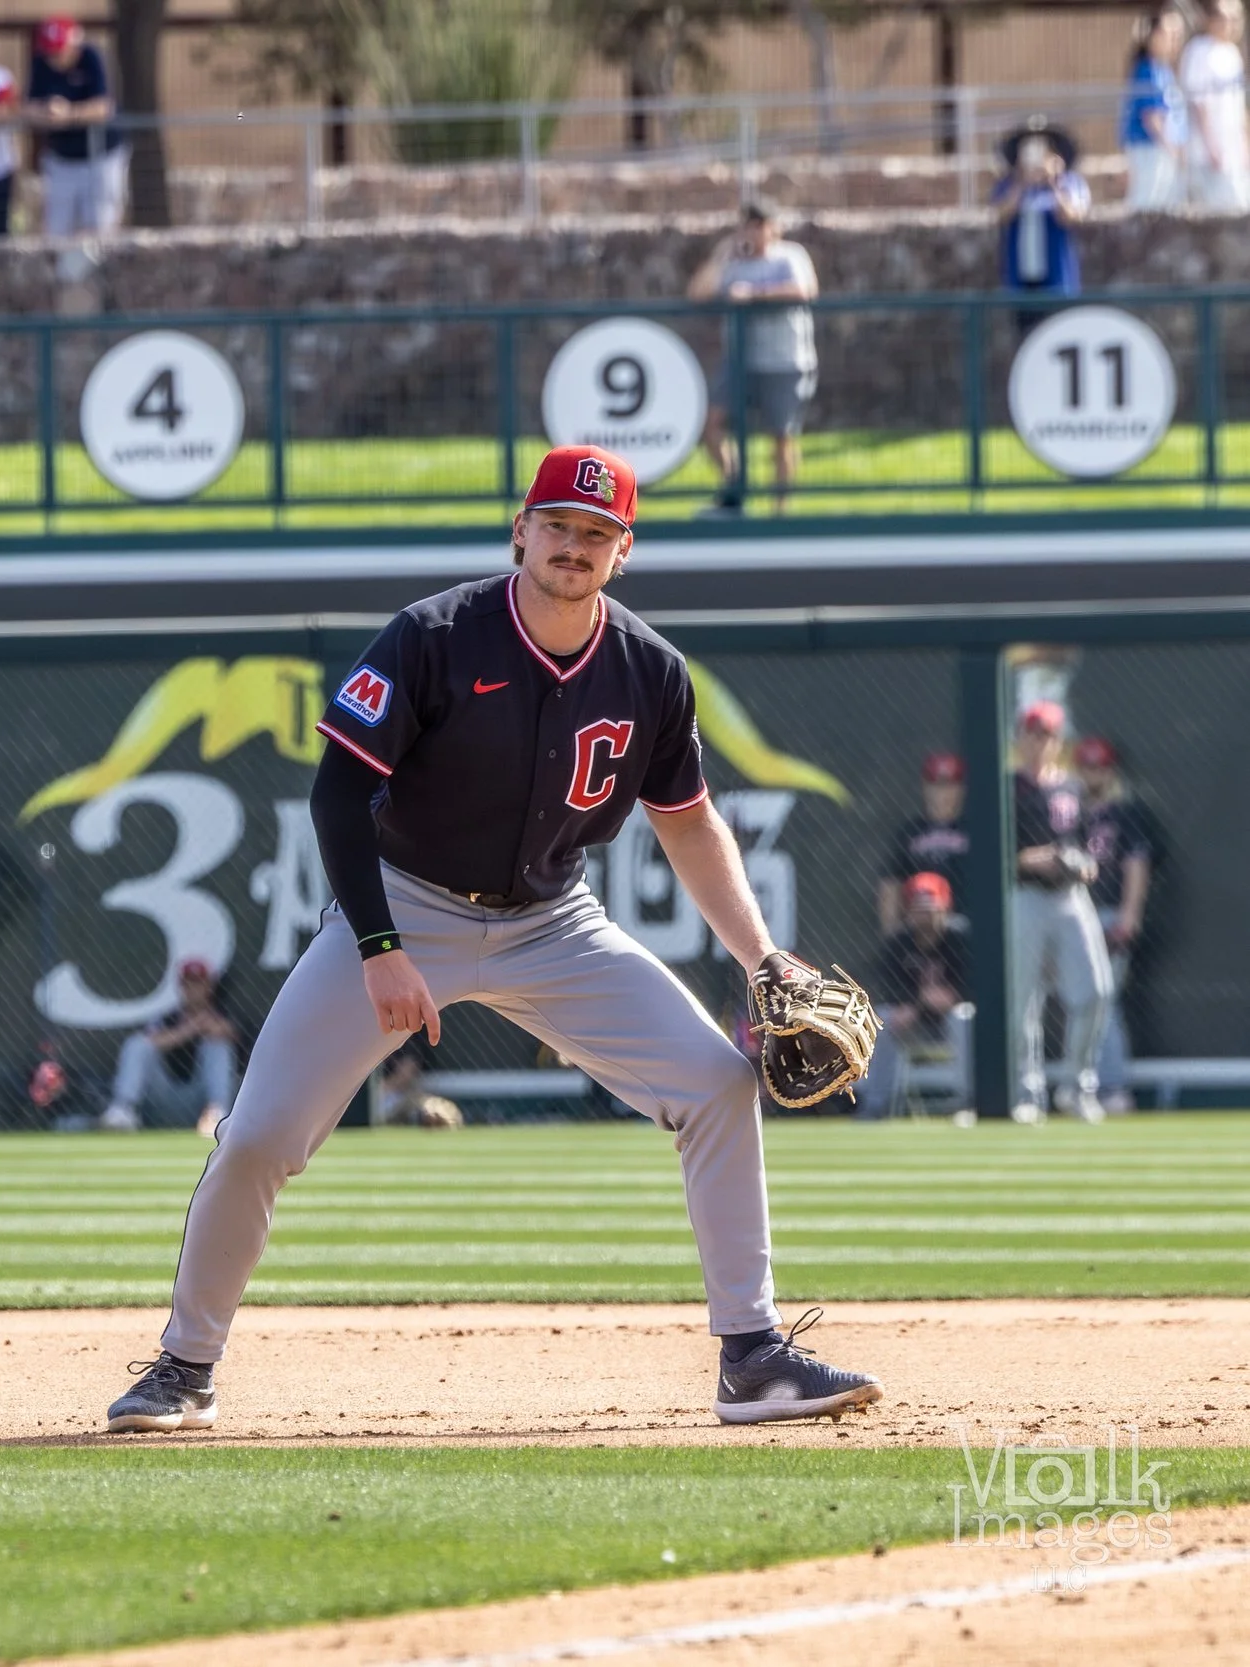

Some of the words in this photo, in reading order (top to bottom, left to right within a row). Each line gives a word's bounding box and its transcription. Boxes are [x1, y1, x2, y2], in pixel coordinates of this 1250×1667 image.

[131, 367, 186, 433] 4
[599, 354, 648, 420] 9
[1052, 343, 1126, 410] 11
[573, 457, 606, 495] C
[339, 692, 376, 721] Marathon
[345, 671, 386, 713] M
[564, 717, 635, 812] C
[33, 771, 244, 1029] 3
